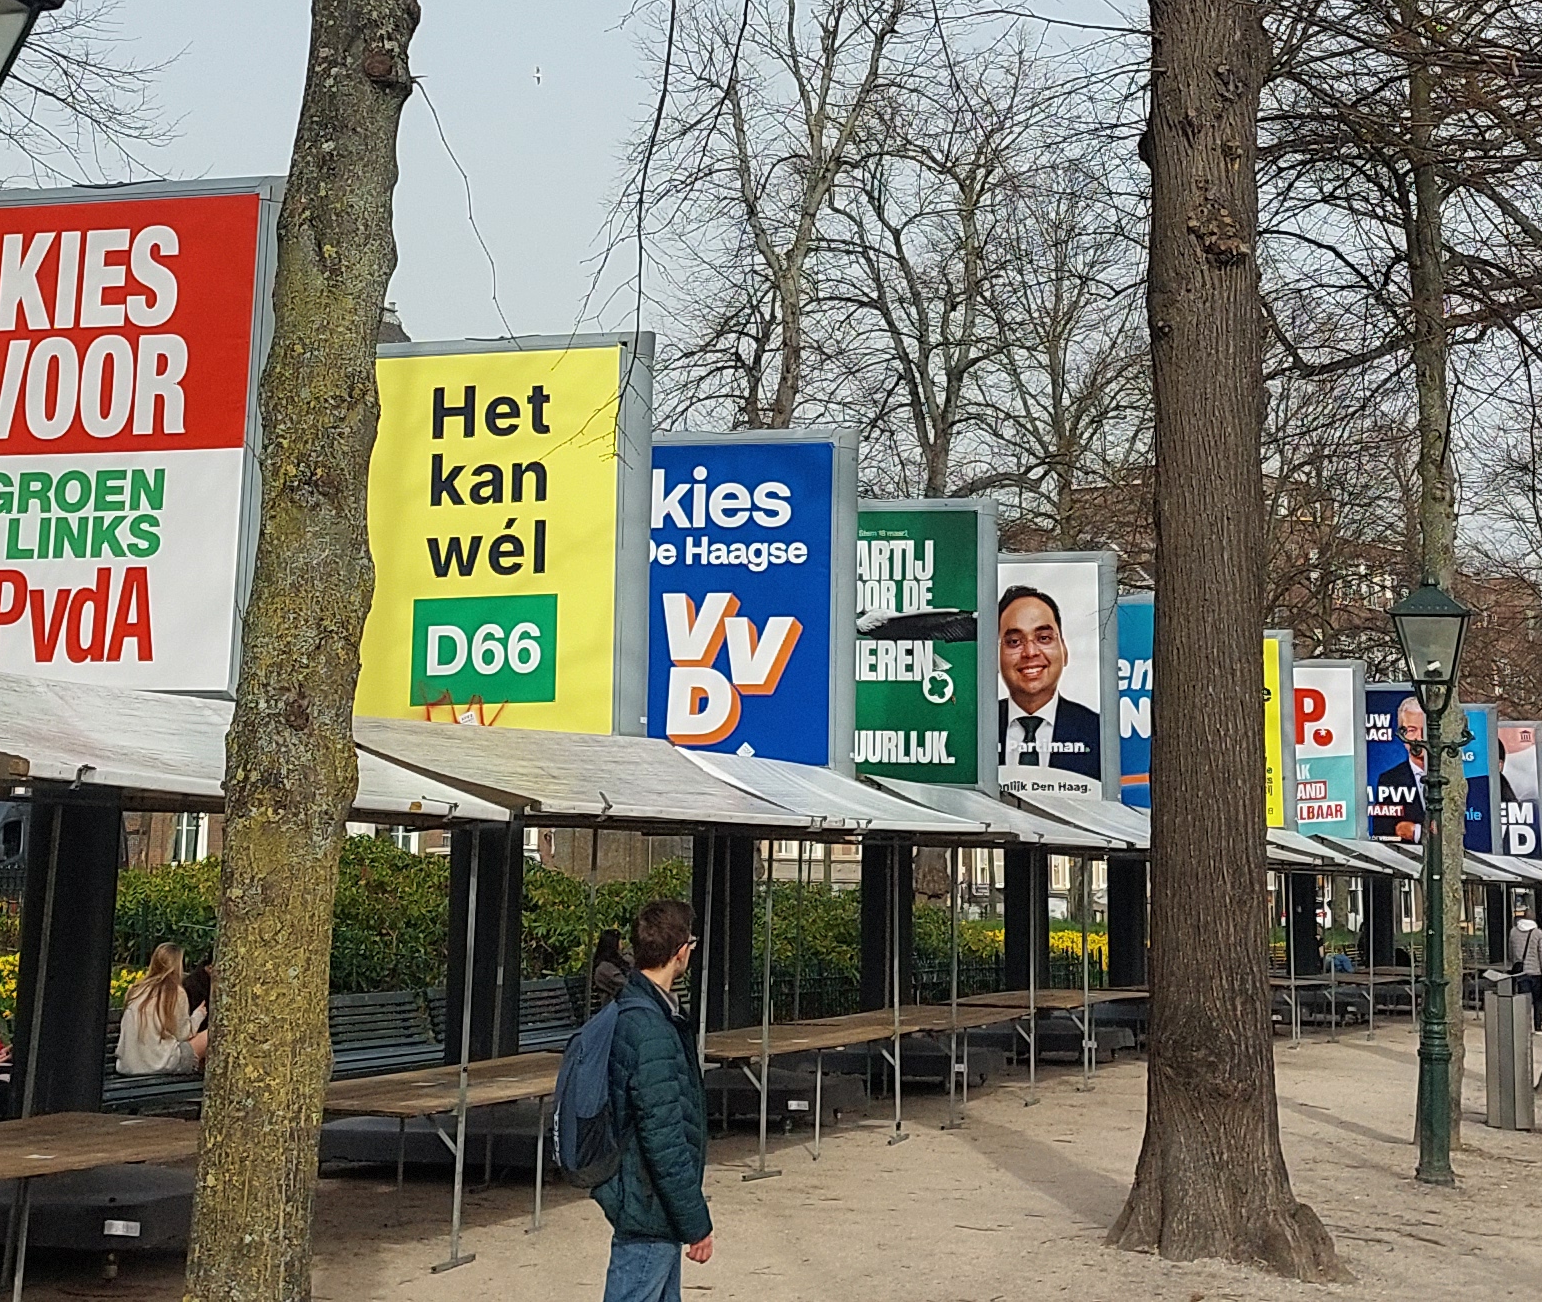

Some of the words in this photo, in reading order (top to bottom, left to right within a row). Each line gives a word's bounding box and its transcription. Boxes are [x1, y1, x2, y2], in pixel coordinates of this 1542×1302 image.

[432, 385, 551, 439] Het
[430, 453, 547, 507] kan
[651, 466, 792, 529] kies
[5, 514, 161, 561] LINKS
[427, 518, 546, 578] wél
[685, 536, 808, 571] Haagse
[902, 580, 934, 613] DE
[426, 622, 542, 677] D66
[1031, 781, 1055, 792] Den
[1058, 781, 1092, 794] Haag.
[1378, 786, 1416, 803] PVV
